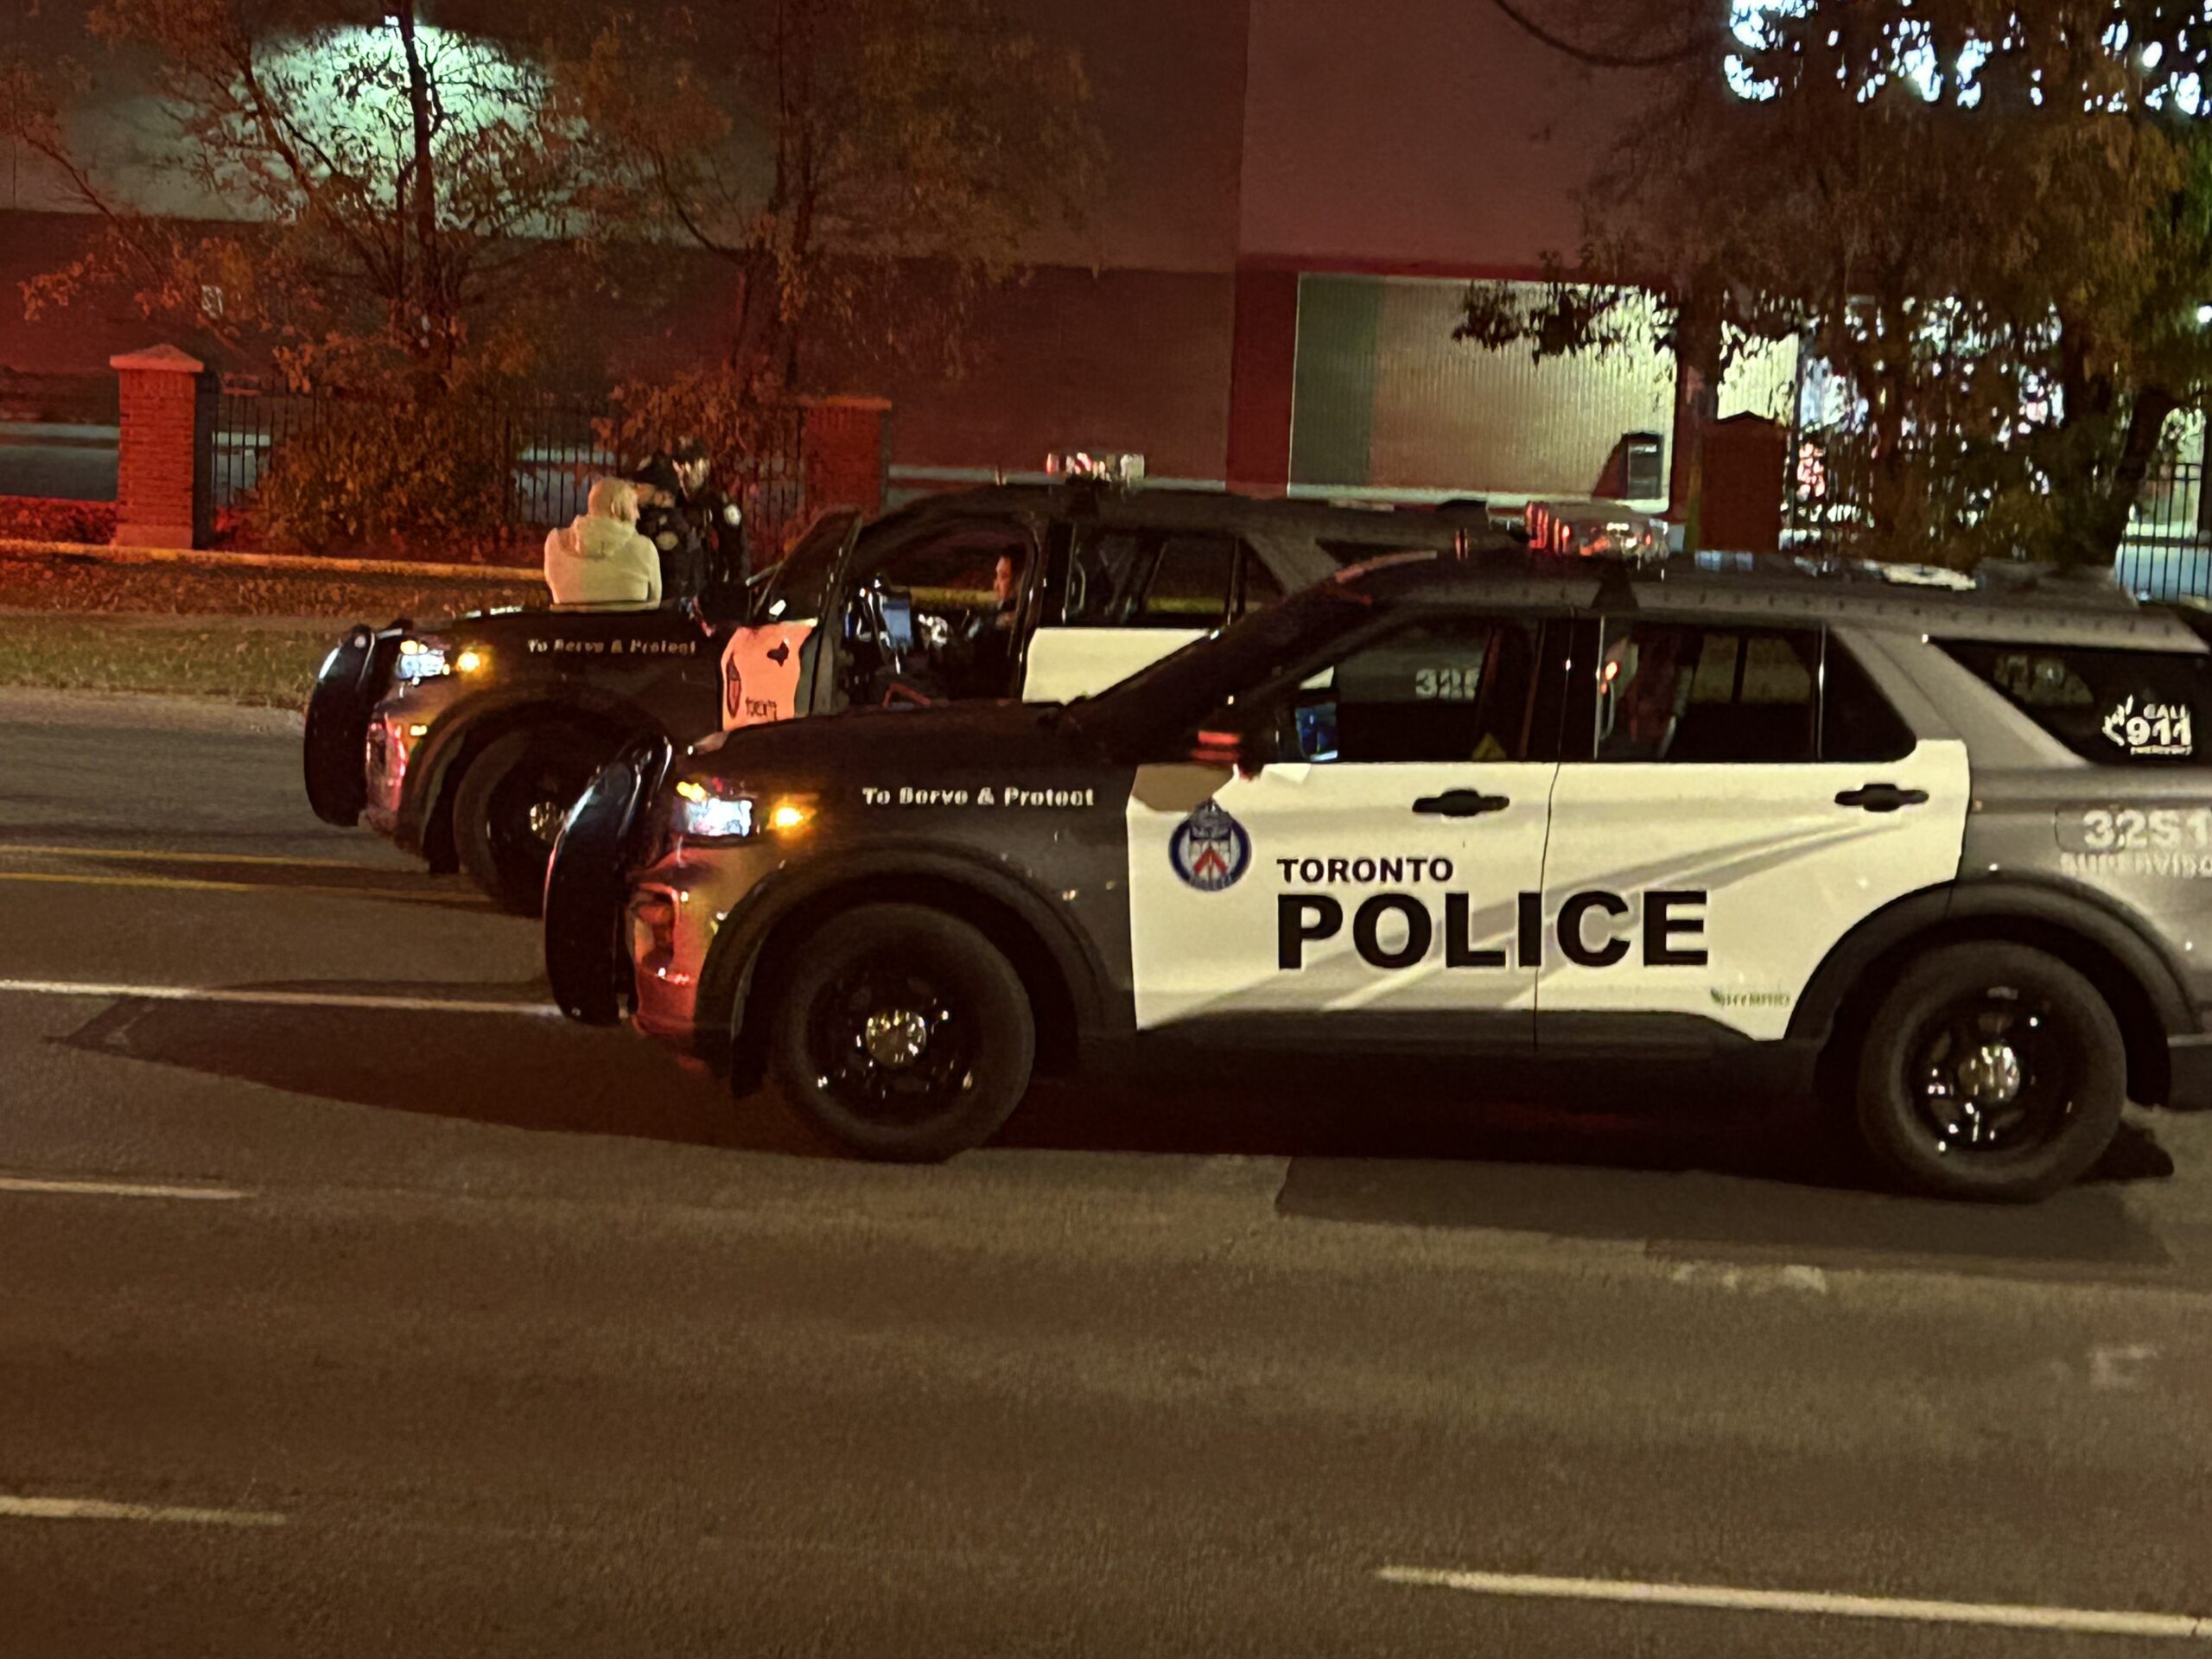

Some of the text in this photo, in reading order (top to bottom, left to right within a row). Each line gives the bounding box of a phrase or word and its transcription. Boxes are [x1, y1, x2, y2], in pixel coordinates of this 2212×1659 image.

[2126, 716, 2191, 746] 911
[862, 787, 890, 805] To
[1276, 857, 1454, 884] TORONTO
[1276, 890, 1709, 971] POLICE
